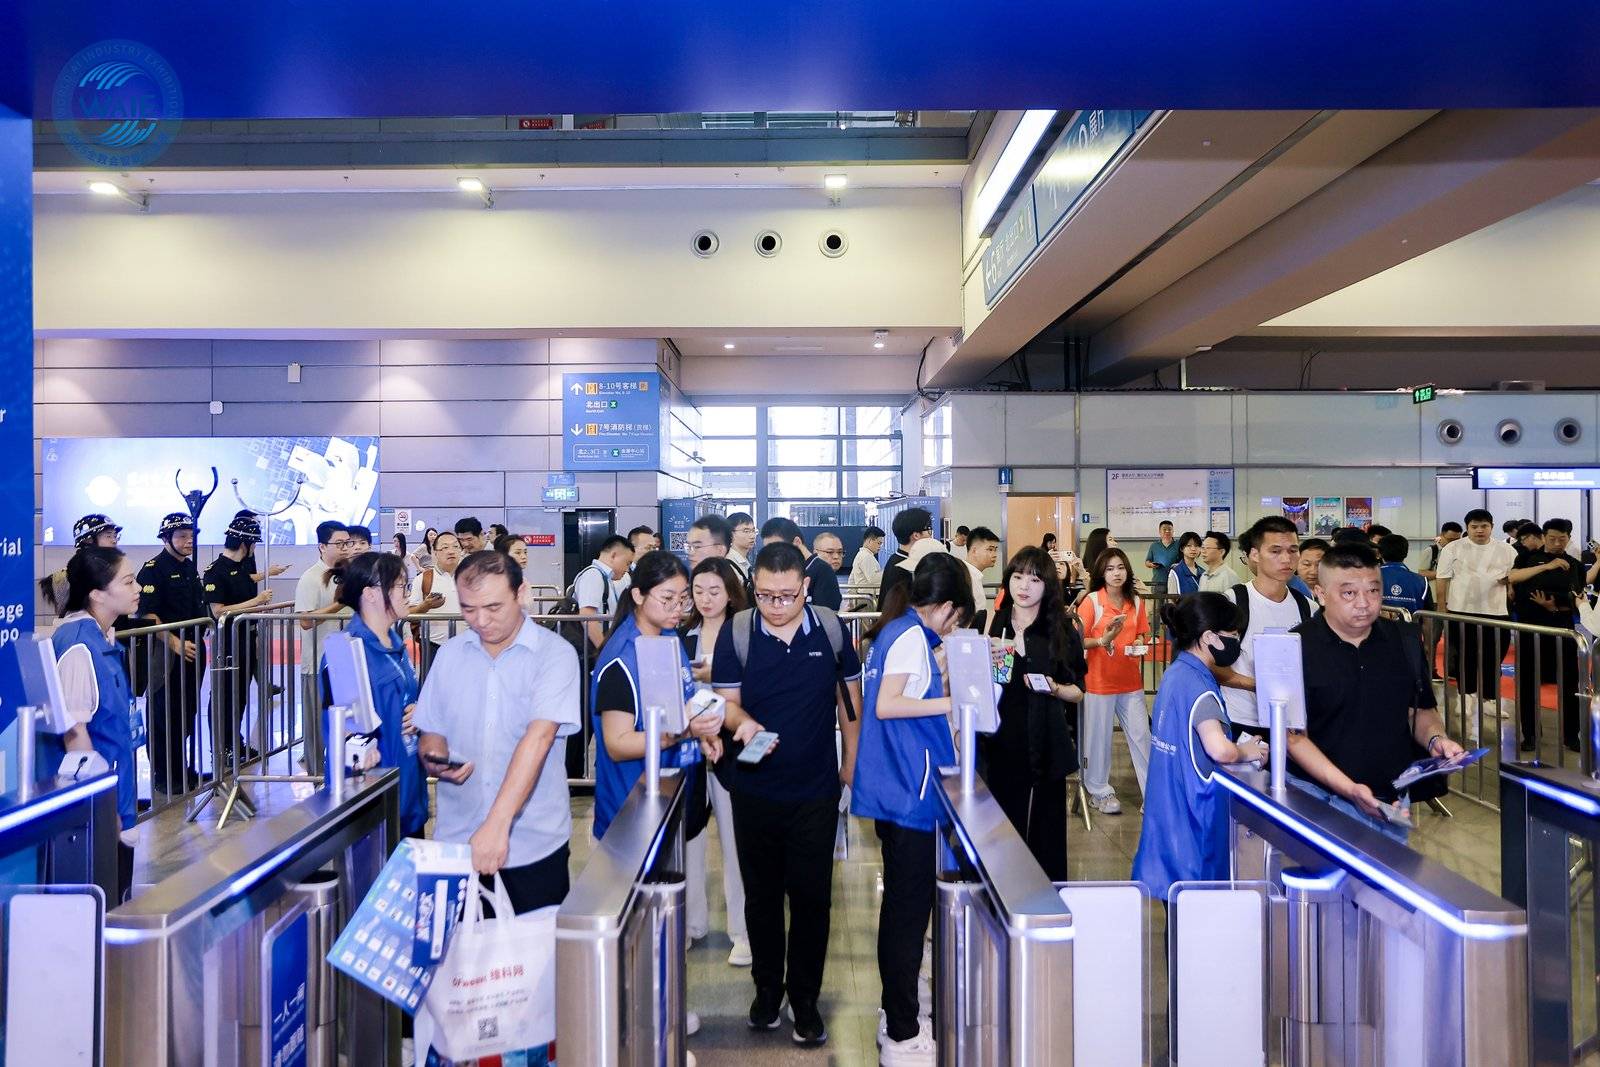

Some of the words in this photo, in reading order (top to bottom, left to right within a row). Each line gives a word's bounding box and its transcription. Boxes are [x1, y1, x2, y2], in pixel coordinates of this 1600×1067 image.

[586, 400, 608, 408] 北出口
[0, 627, 19, 648] po
